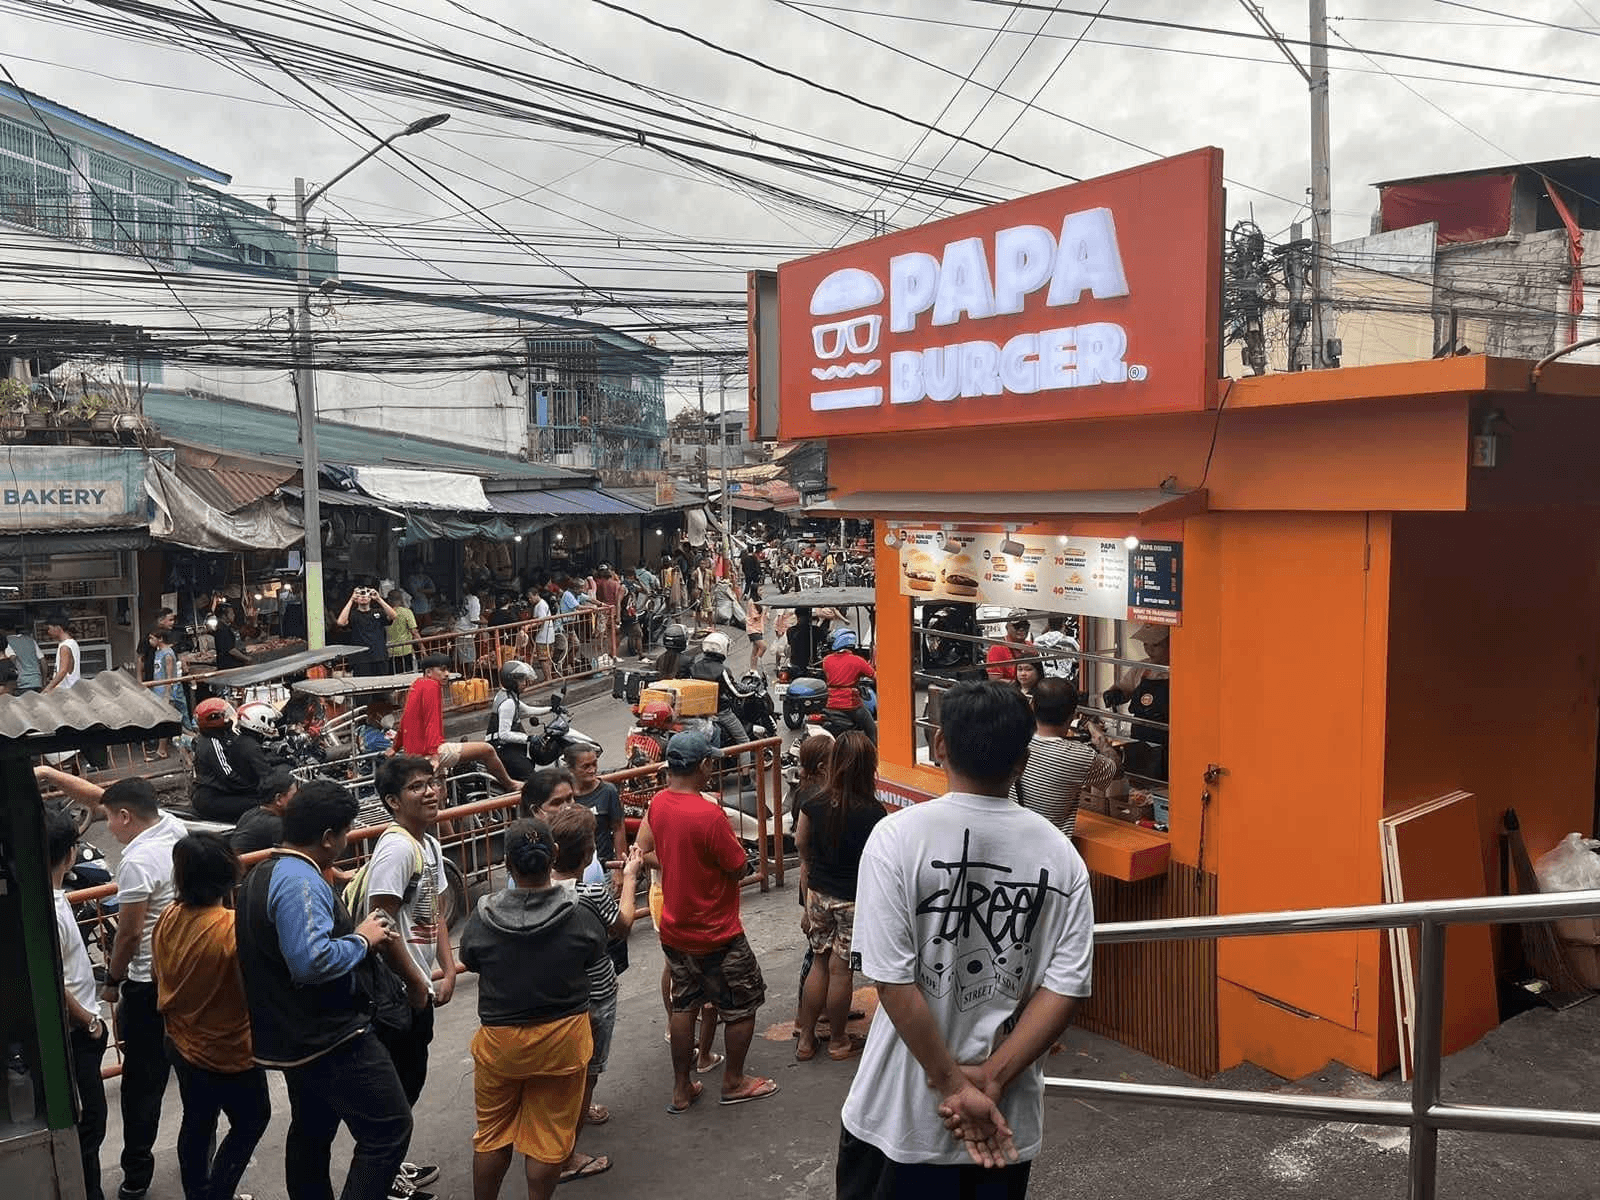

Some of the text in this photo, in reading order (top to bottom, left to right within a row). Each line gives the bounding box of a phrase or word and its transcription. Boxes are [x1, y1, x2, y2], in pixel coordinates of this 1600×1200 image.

[890, 207, 1129, 333] PAPA
[890, 322, 1128, 404] BURGER
[4, 489, 106, 505] BAKERY
